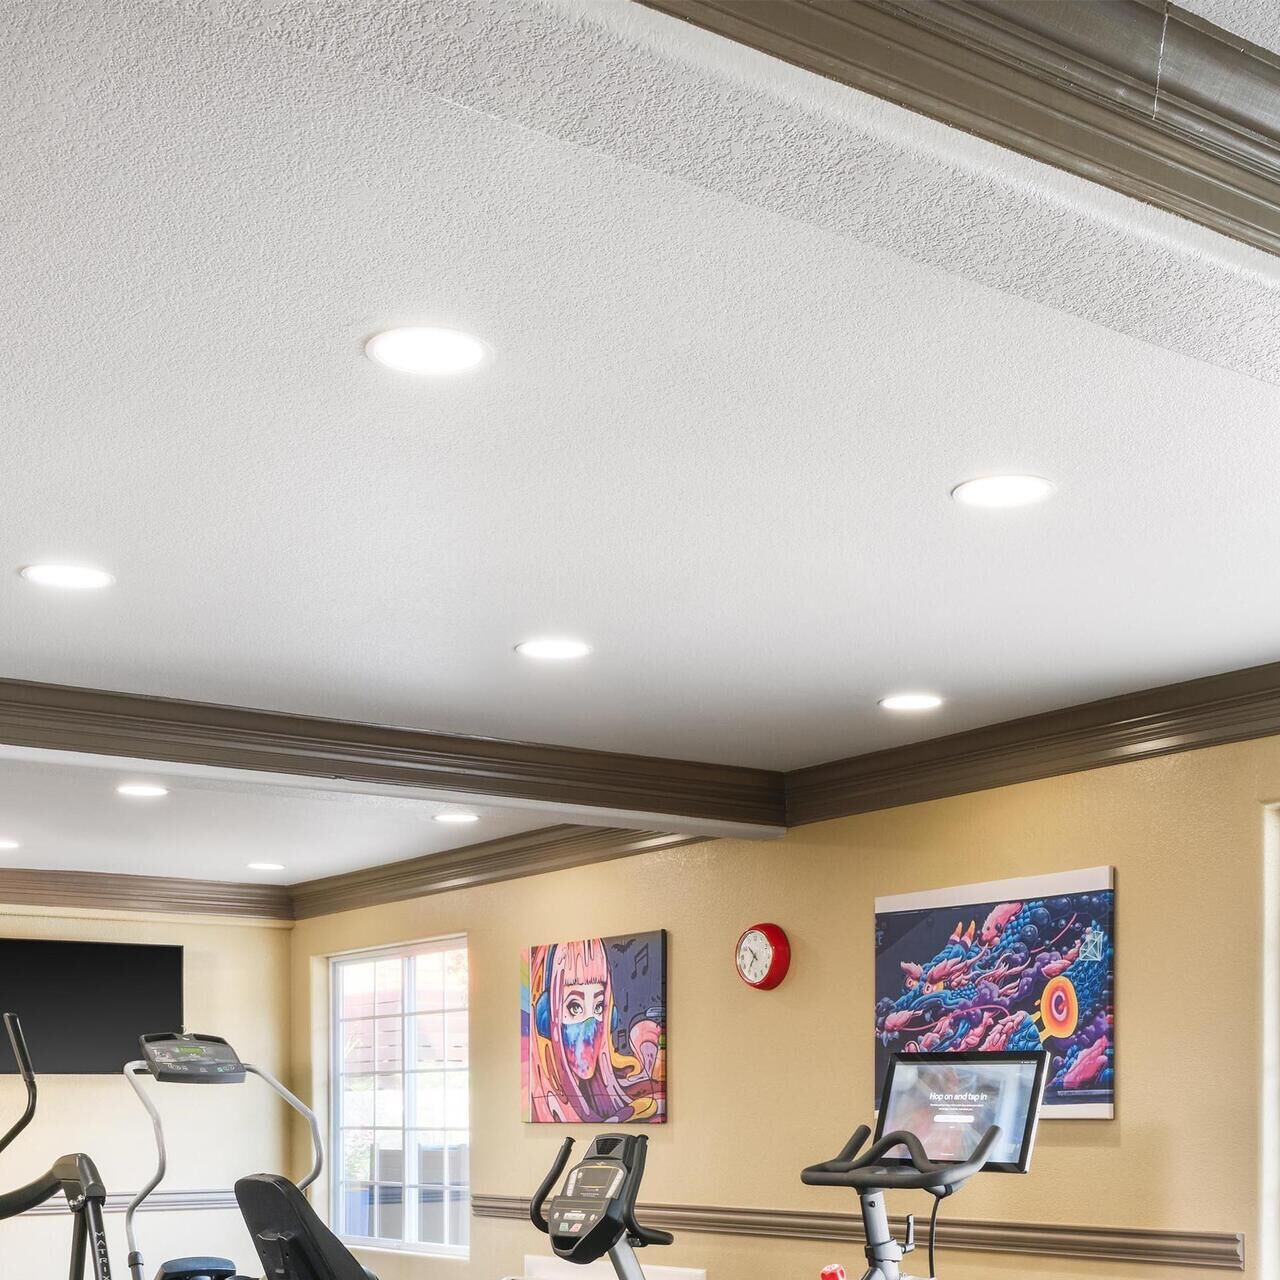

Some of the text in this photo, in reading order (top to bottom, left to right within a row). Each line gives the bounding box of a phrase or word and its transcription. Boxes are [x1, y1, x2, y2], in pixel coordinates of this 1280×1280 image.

[929, 1092, 944, 1102] Hop
[954, 1092, 968, 1101] and
[968, 1093, 980, 1103] tap
[980, 1092, 988, 1101] in
